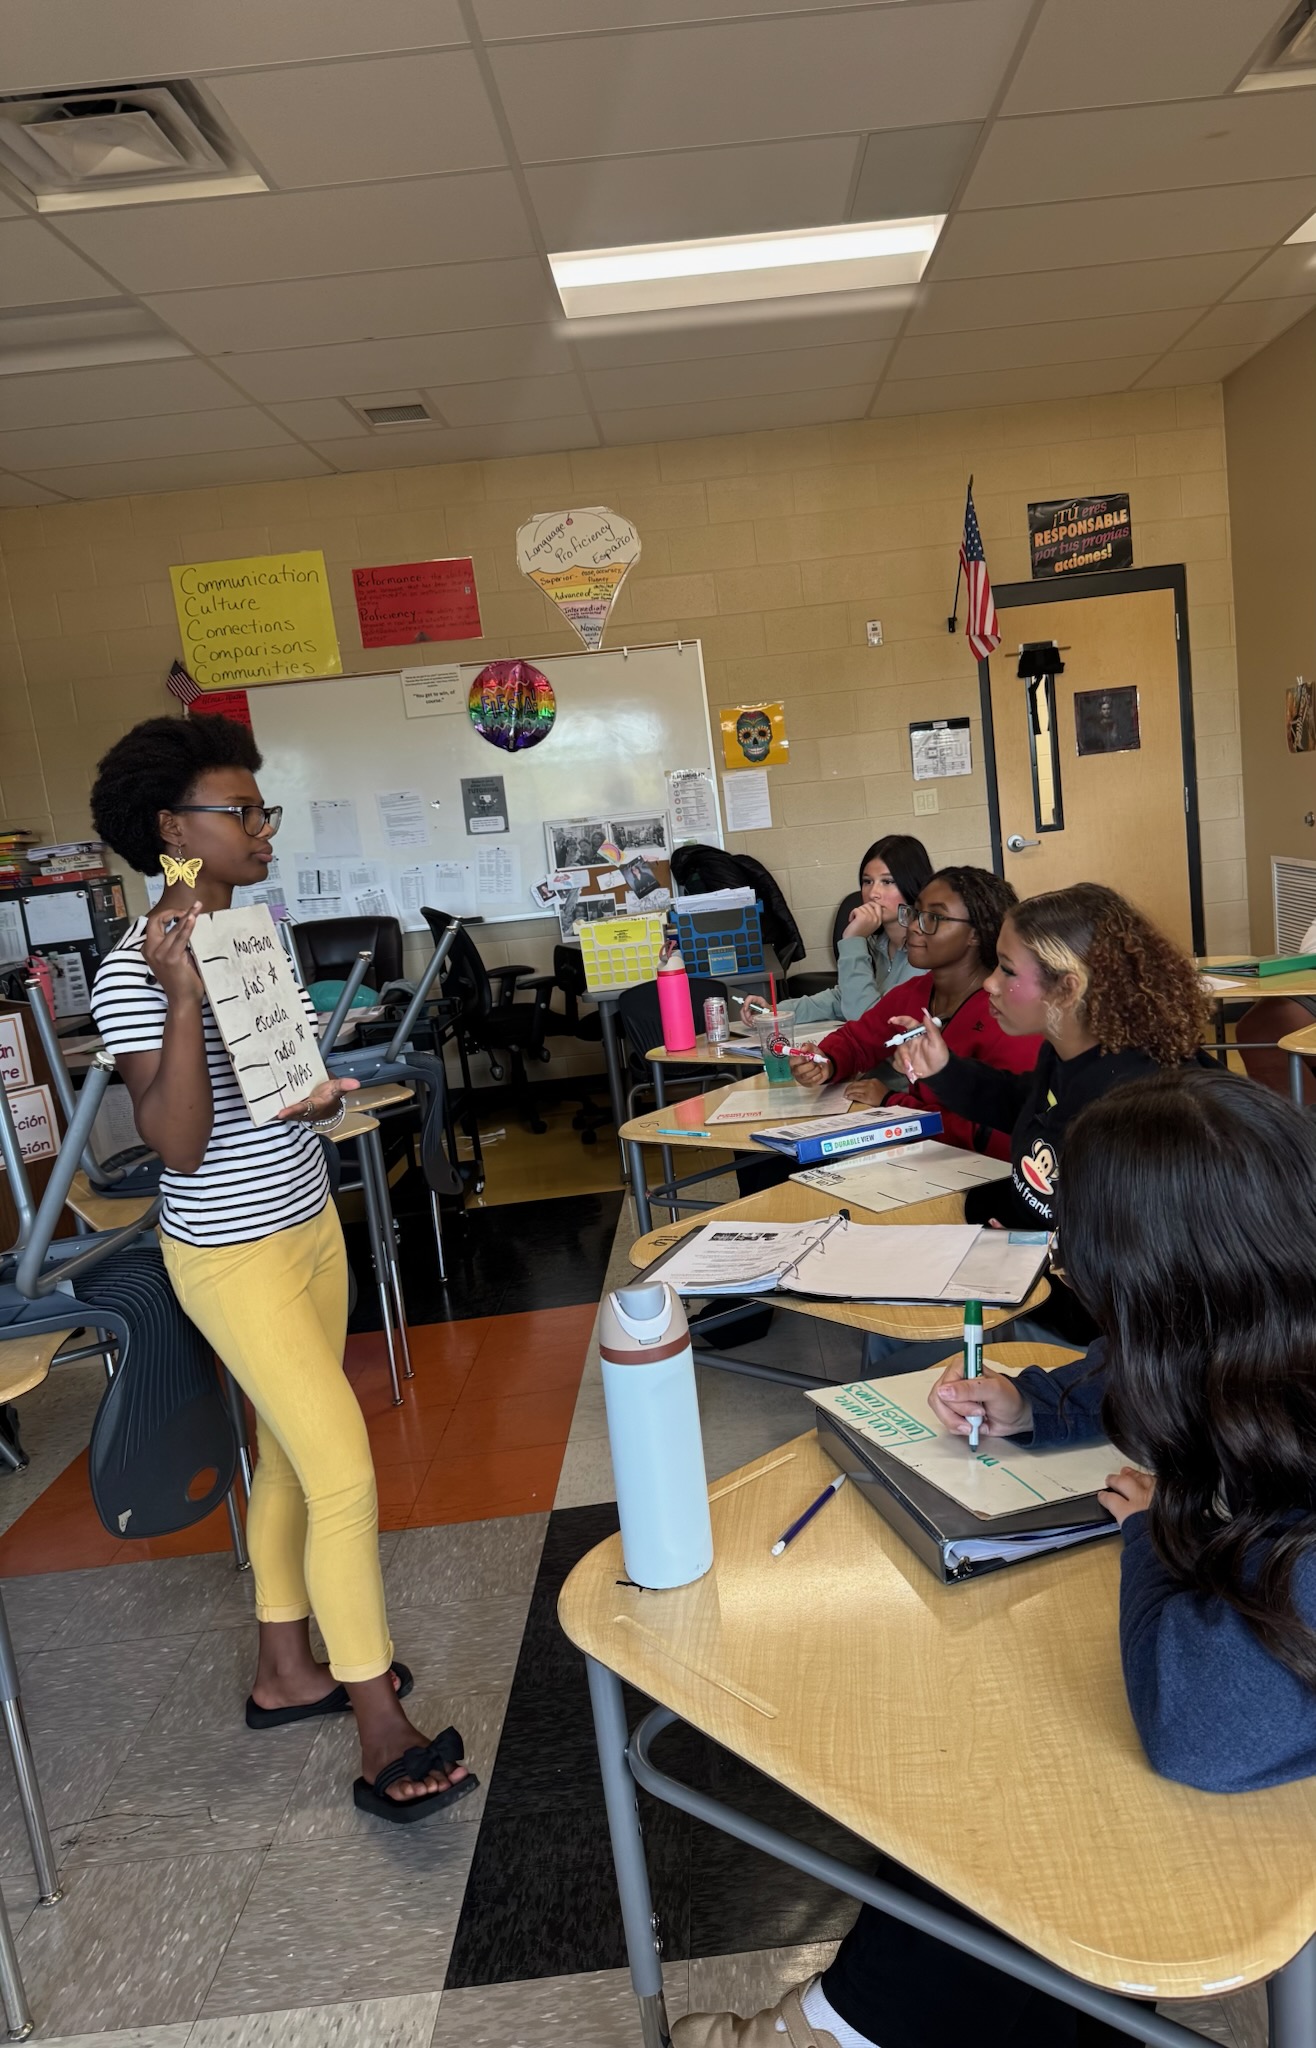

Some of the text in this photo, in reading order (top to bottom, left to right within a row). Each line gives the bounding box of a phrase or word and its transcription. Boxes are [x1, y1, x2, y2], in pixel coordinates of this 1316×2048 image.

[1082, 502, 1107, 518] eres
[1034, 508, 1128, 548] RESPONSABLE
[525, 523, 565, 561] Language
[555, 523, 616, 563] Proficiency
[1034, 526, 1129, 566] por tus propias
[1054, 543, 1112, 573] acciones!
[180, 564, 320, 595] Communication
[540, 574, 573, 585] Superior
[184, 596, 261, 617] Culture
[358, 607, 416, 622] Proficiency
[186, 619, 296, 642] Connections
[192, 639, 317, 664] Comparisons
[194, 660, 316, 685] Communities
[481, 689, 538, 719] FIESTA!
[256, 1002, 289, 1033] escuela
[274, 1040, 296, 1064] radio
[834, 1134, 875, 1149] DURABLE VIEW
[1021, 1187, 1053, 1219] frank
